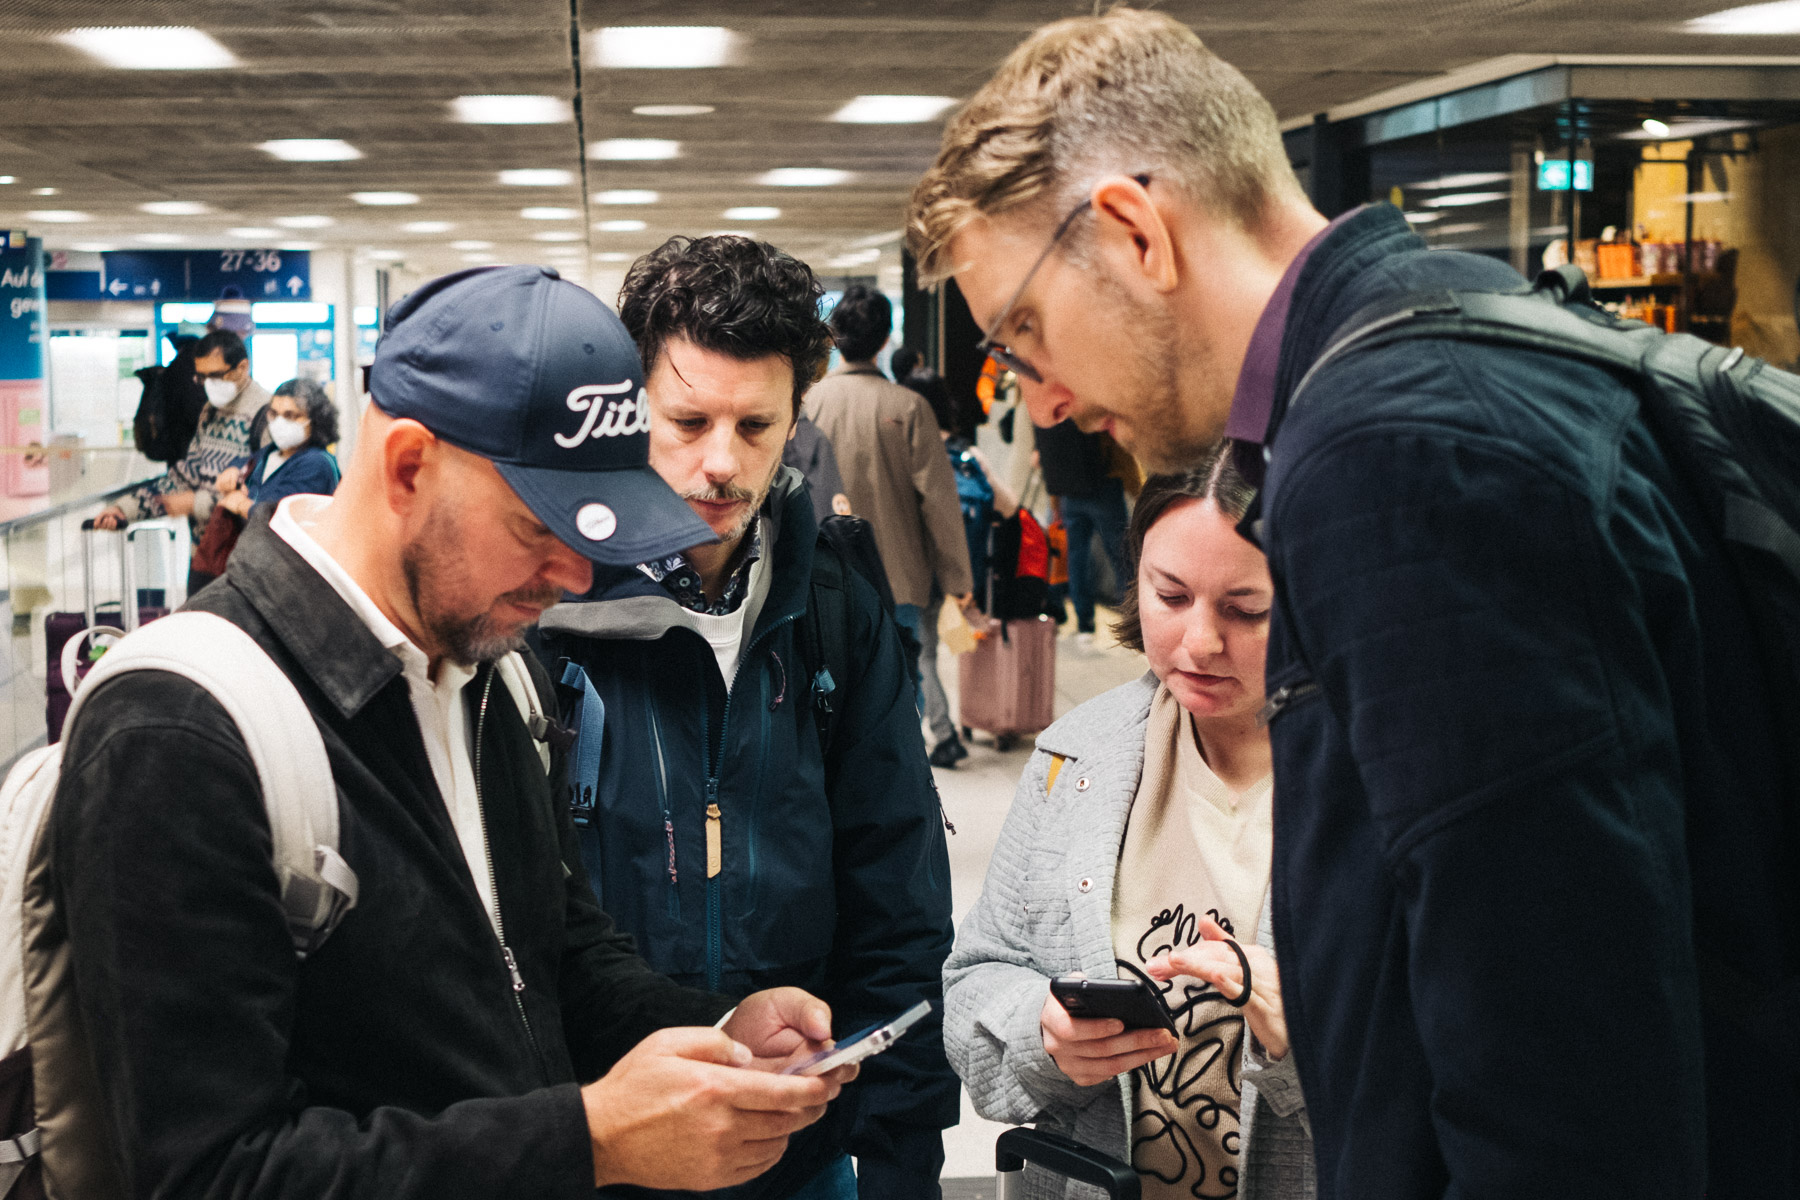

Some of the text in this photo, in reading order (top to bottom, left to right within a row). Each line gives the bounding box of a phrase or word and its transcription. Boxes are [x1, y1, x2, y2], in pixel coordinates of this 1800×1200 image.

[220, 249, 281, 272] 27-36
[0, 266, 29, 288] Auf
[554, 379, 650, 448] Titl
